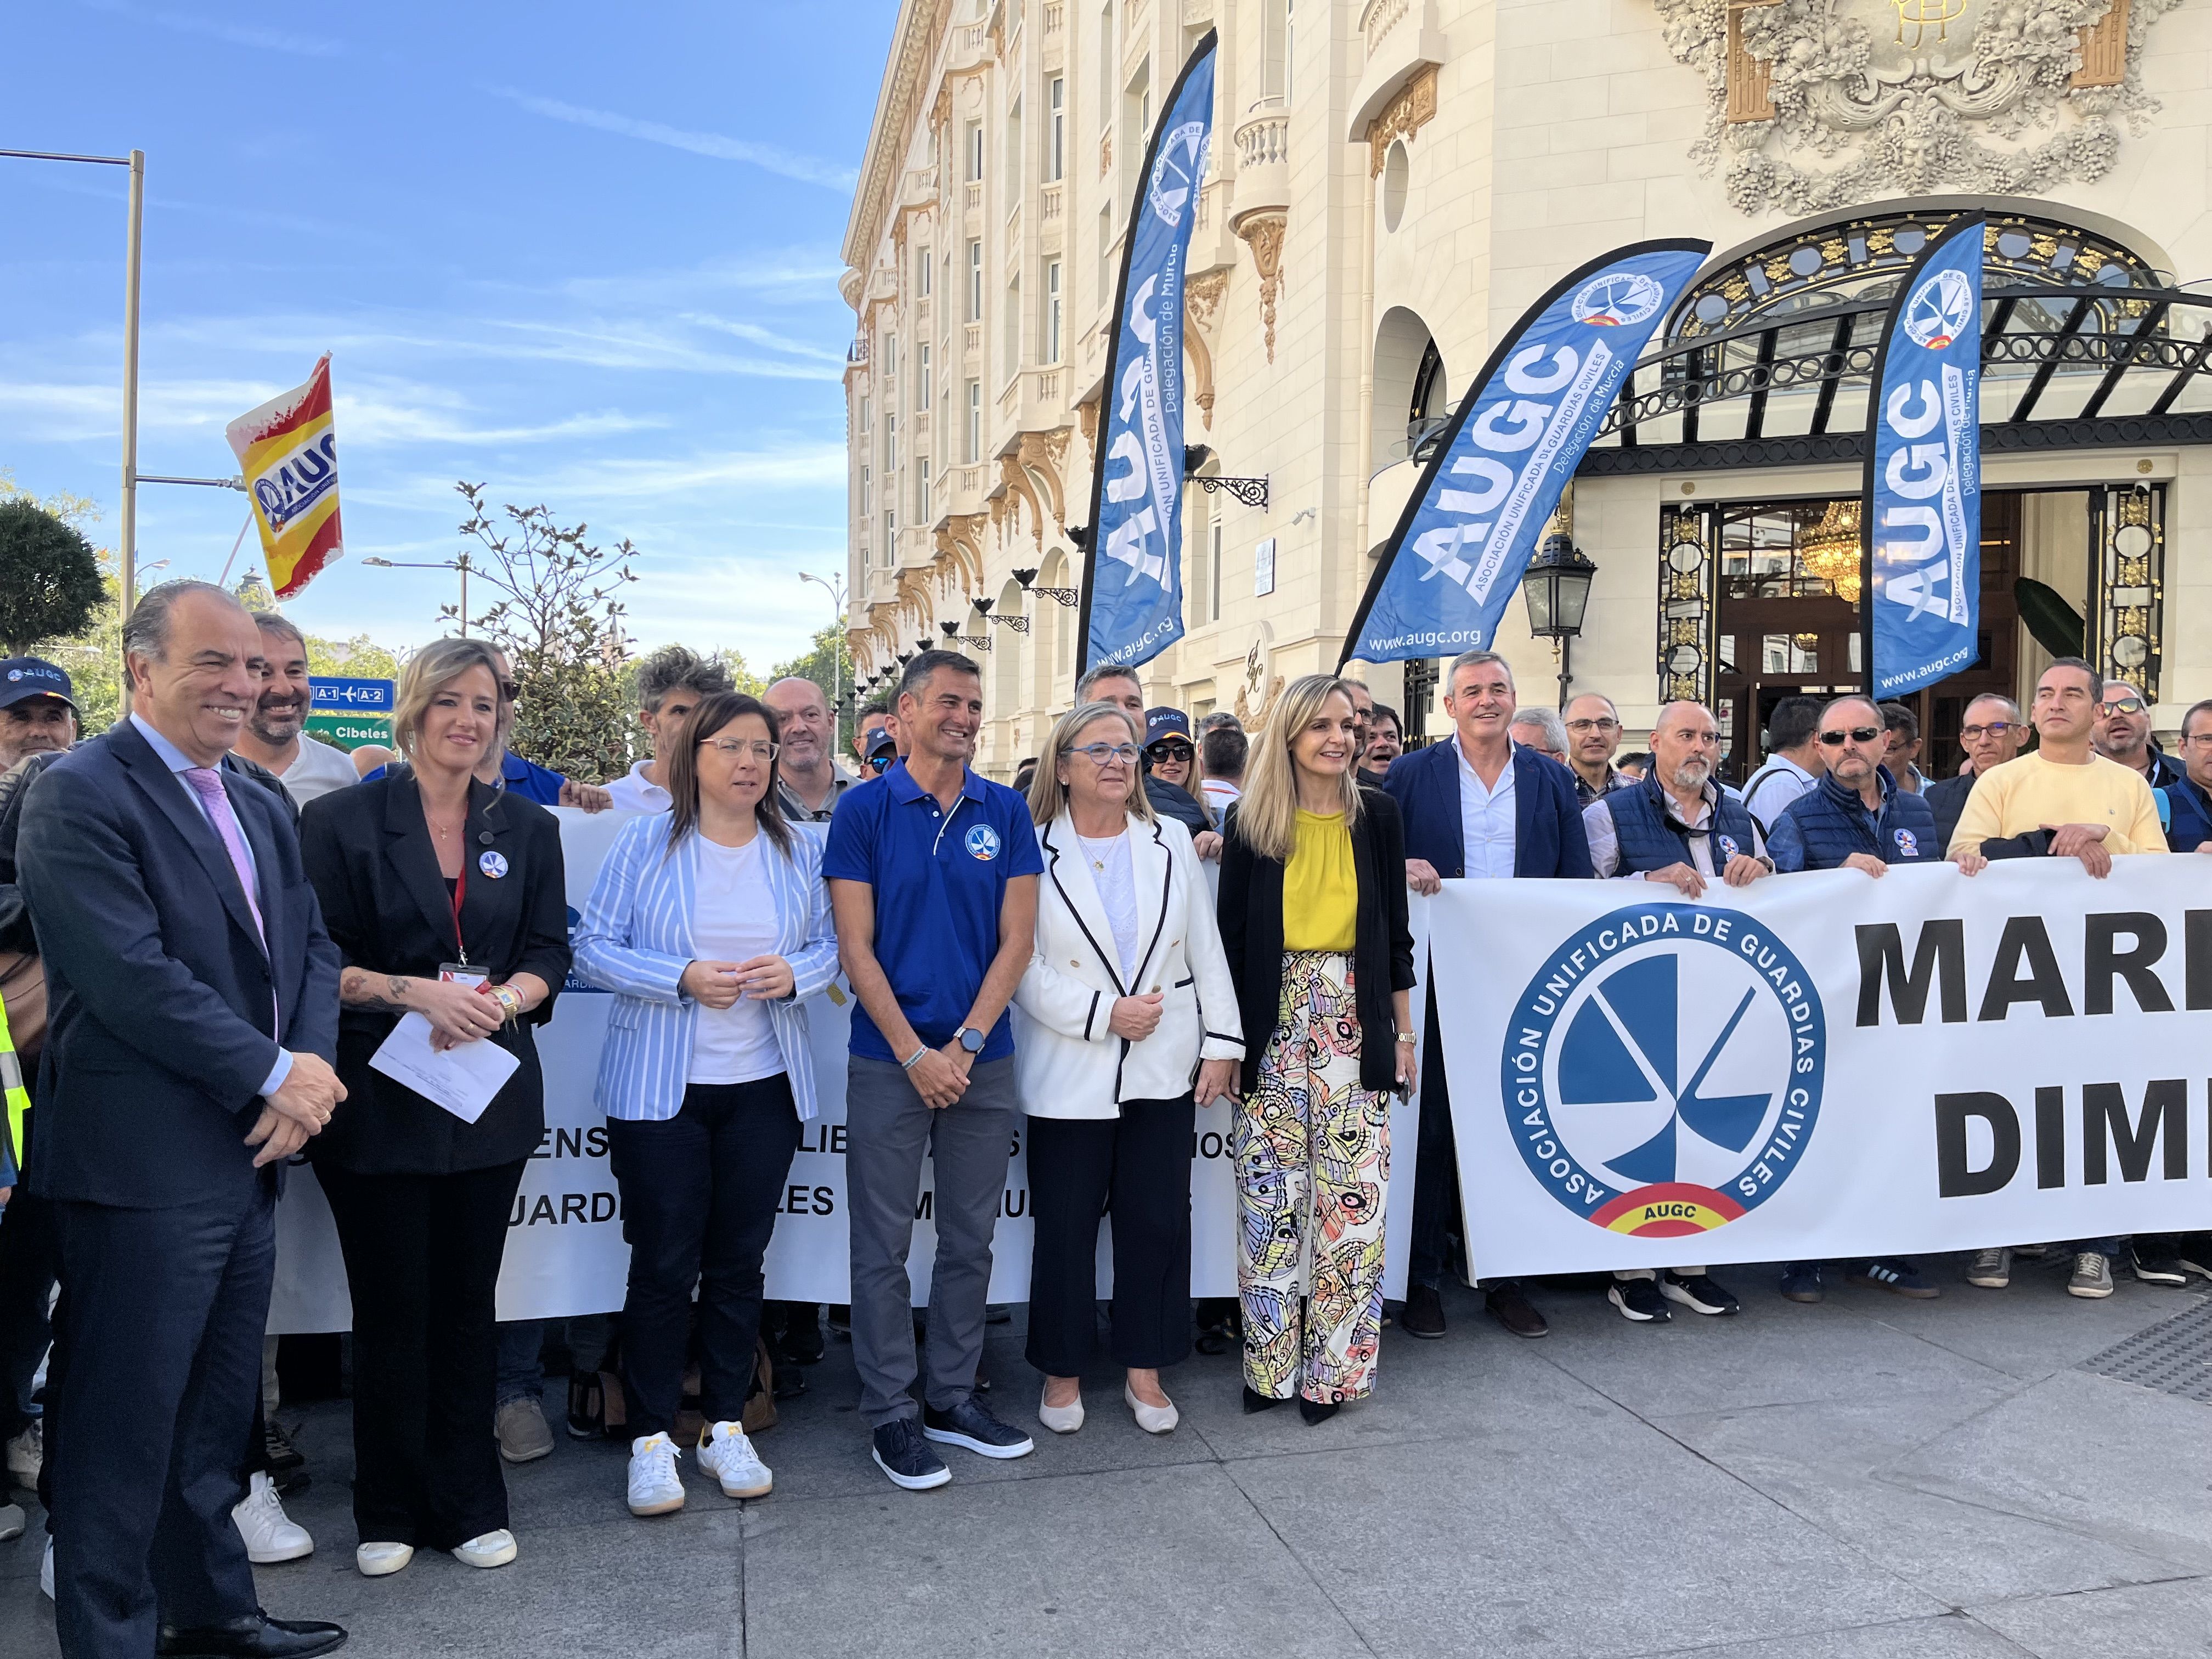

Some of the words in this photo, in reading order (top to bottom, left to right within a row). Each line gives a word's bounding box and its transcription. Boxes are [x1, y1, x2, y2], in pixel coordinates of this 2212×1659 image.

[1161, 244, 1178, 296] Murcia
[1159, 302, 1173, 320] de
[1159, 325, 1177, 413] Delegación
[1594, 360, 1624, 398] Murcia
[1146, 389, 1154, 408] DE
[1591, 398, 1603, 413] de
[1948, 374, 1960, 416] CIVILES
[1147, 413, 1170, 490] UNIFICADA
[1412, 343, 1579, 586] AUGC
[1553, 414, 1593, 474] Delegación
[1475, 521, 1514, 592] ASOCIACIÓN
[1509, 462, 1544, 518] UNIFICADA
[1538, 449, 1551, 459] DE
[1548, 392, 1583, 448] GUARDIAS
[1578, 353, 1605, 390] CIVILES
[1946, 479, 1954, 493] DE
[1885, 379, 1948, 622] AUGC
[1947, 496, 1963, 549] UNIFICADA
[1369, 630, 1481, 651] www.augc.org
[24, 668, 61, 682] AUGC
[318, 688, 337, 698] A-1
[360, 690, 381, 700] A-2
[336, 726, 388, 739] Cibeles
[1157, 714, 1182, 722] AUGC
[1693, 913, 1733, 941] DE
[1532, 912, 1680, 1017] UNIFICADA
[1740, 934, 1815, 1074] GUARDIAS
[1512, 1027, 1605, 1205] ASOCIACIÓN
[1934, 1078, 2212, 1198] DIM
[1739, 1088, 1809, 1197] CIVILES
[1644, 1204, 1697, 1220] AUGC
